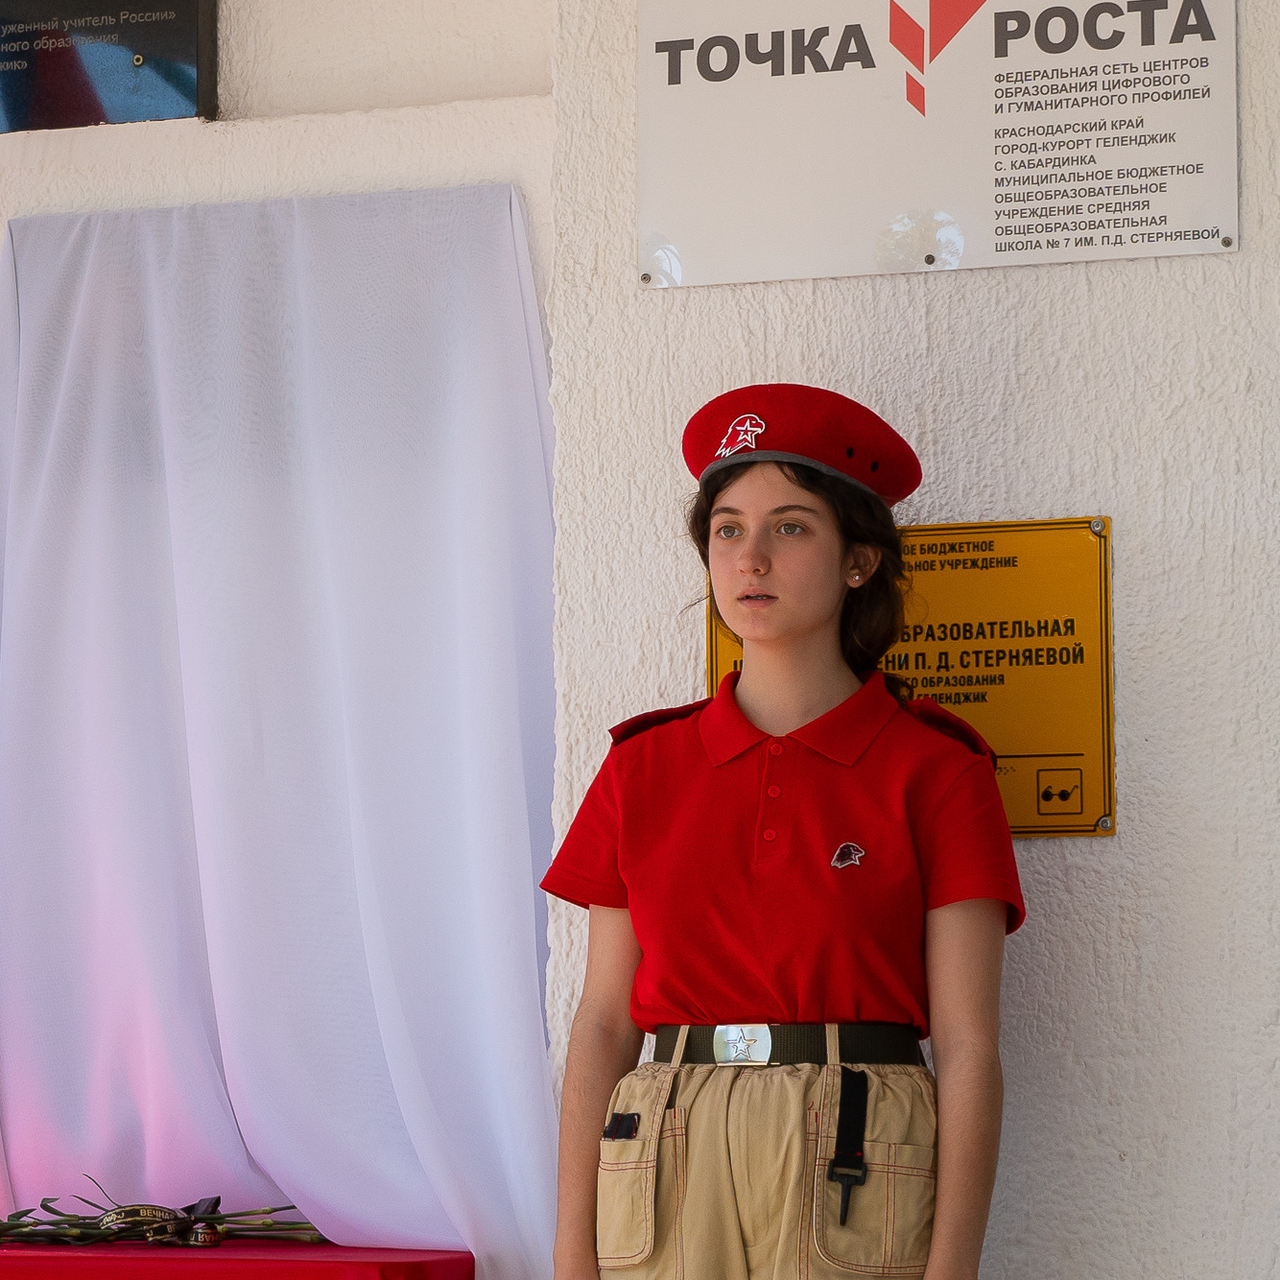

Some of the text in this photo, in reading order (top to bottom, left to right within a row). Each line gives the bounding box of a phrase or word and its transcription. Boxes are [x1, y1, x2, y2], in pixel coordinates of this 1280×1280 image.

[63, 16, 116, 31] учитель
[120, 11, 176, 24] России»
[33, 34, 119, 52] образования
[656, 24, 876, 85] ТОЧКА
[994, 57, 1209, 84] ФЕДЕРАЛЬНАЯ СЕТЬ ЦЕНТРОВ
[994, 74, 1190, 99] ОБРАЗОВАНИЯ ЦИФРОВОГО
[995, 85, 1210, 114] И ГУМАНИТАРНОГО ПРОФИЛЕЙ
[995, 116, 1144, 139] КРАСНОДАРСКИЙ КРАЙ
[995, 132, 1176, 155] ГОРОД-КУРОРТ ГЕЛЕНДЖИК
[995, 155, 1096, 171] С. КАБАРДИНКА
[995, 163, 1204, 187] МУНИЦИПАЛЬНОЕ БЮДЖЕТНОЕ
[995, 182, 1167, 203] ОБЩЕОБРАЗОВАТЕЛЬНОЕ
[994, 200, 1150, 220] УЧРЕЖДЕНИЕ СРЕДНЯЯ
[995, 215, 1167, 236] ОБЩЕОБРАЗОВАТЕЛЬНАЯ
[995, 226, 1219, 252] ШКОЛА № 7 ИМ. П.Д. СТЕРНЯЕВОЙ
[919, 541, 994, 556] БЮДЖЕТНОЕ
[939, 556, 1019, 570] УЧРЕЖДЕНИЕ
[900, 618, 1075, 643] БРАЗОВАТЕЛЬНАЯ
[914, 652, 931, 670] П.
[936, 651, 954, 673] Д.
[959, 642, 1084, 669] СТЕРНЯЕВОЙ
[921, 674, 1005, 688] ОБРАЗОВАНИЯ
